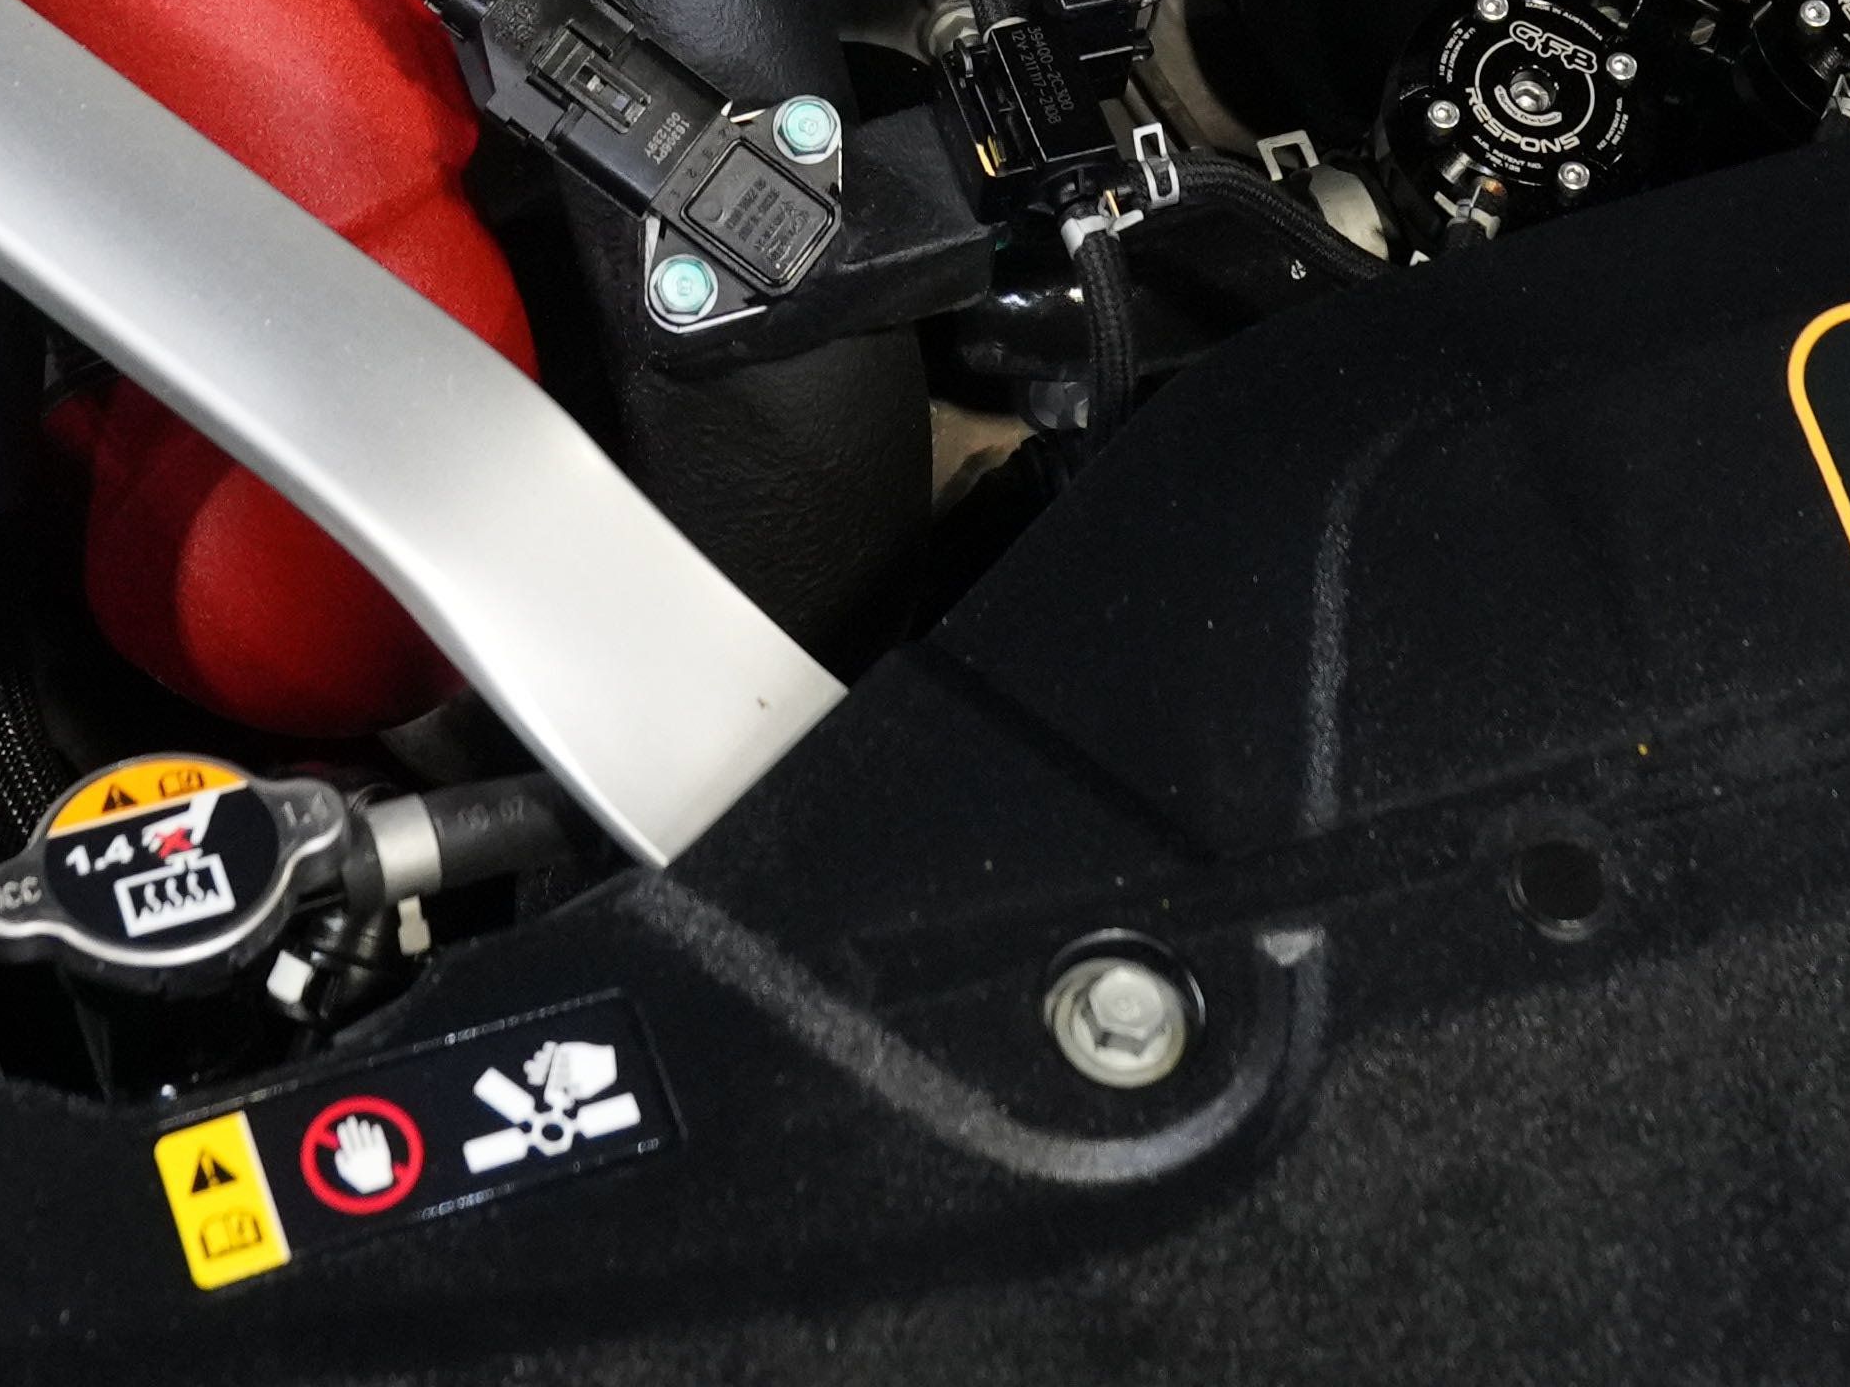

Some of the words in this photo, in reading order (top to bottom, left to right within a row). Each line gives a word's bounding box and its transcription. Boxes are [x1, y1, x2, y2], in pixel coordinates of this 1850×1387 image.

[1562, 12, 1603, 41] AUSTRALIA
[1509, 20, 1597, 74] GFB
[1489, 149, 1525, 166] PATENT
[64, 833, 136, 877] 1.4
